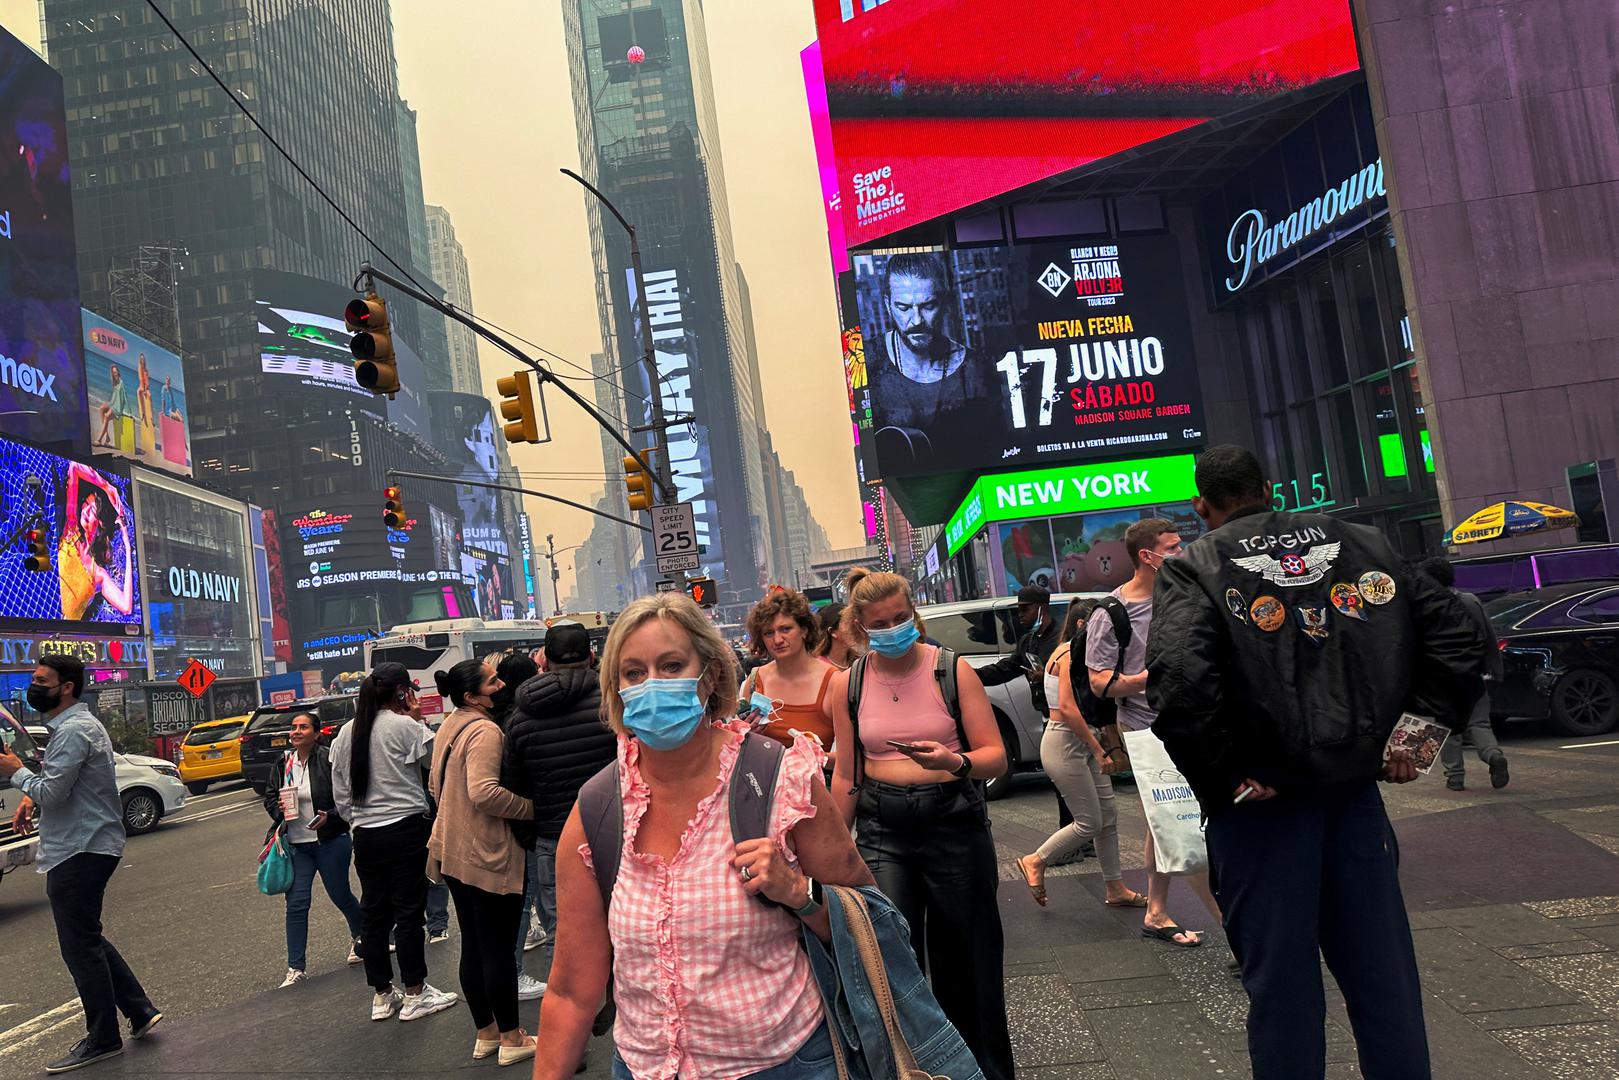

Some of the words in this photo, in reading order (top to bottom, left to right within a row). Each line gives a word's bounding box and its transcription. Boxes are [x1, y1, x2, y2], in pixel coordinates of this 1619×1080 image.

[853, 165, 891, 188] Save
[855, 183, 887, 204] The
[856, 193, 905, 220] Music
[858, 206, 906, 227] FOUNDATION
[1070, 247, 1093, 259] BLANCO
[1047, 272, 1062, 288] BN
[1074, 260, 1122, 281] ARJONA
[642, 268, 685, 345] THAI
[1087, 298, 1102, 307] TOUR
[1102, 297, 1116, 306] 2023
[1037, 318, 1084, 340] NUEVA
[1087, 315, 1134, 335] FECHA
[107, 335, 126, 350] NAVY
[1066, 336, 1165, 384] JUNIO
[996, 347, 1058, 429] 17
[1070, 381, 1155, 411] SÁBADO
[1074, 412, 1115, 426] MADISON
[1118, 408, 1153, 422] SQUARE
[1155, 403, 1191, 418] GARDEN
[350, 420, 363, 466] 1500
[1036, 444, 1062, 453] BOLETOS
[1077, 440, 1086, 449] LA
[1086, 438, 1105, 448] VENTA
[1105, 432, 1168, 447] RICARDOARJONA.COM
[996, 479, 1064, 508] NEW
[1071, 470, 1152, 500] YORK
[660, 514, 684, 523] SPEED
[662, 506, 679, 515] CITY
[299, 524, 343, 541] Years
[519, 513, 530, 539] Locker
[663, 522, 682, 531] LIMIT
[1455, 525, 1505, 541] SABRETT
[660, 530, 692, 552] 25
[661, 562, 696, 571] ENFORCED
[667, 556, 689, 564] PHOTO
[169, 566, 201, 599] OLD
[203, 571, 240, 603] NAVY
[323, 571, 358, 585] SEASON
[360, 570, 396, 580] PREMIERE
[417, 573, 425, 582] 14
[325, 635, 340, 646] CEO
[123, 641, 147, 663] NY
[324, 649, 341, 659] hate
[209, 659, 225, 670] NAVY
[152, 691, 196, 701] DISCOV
[153, 722, 198, 733] SECRET
[1151, 785, 1193, 802] MADISON
